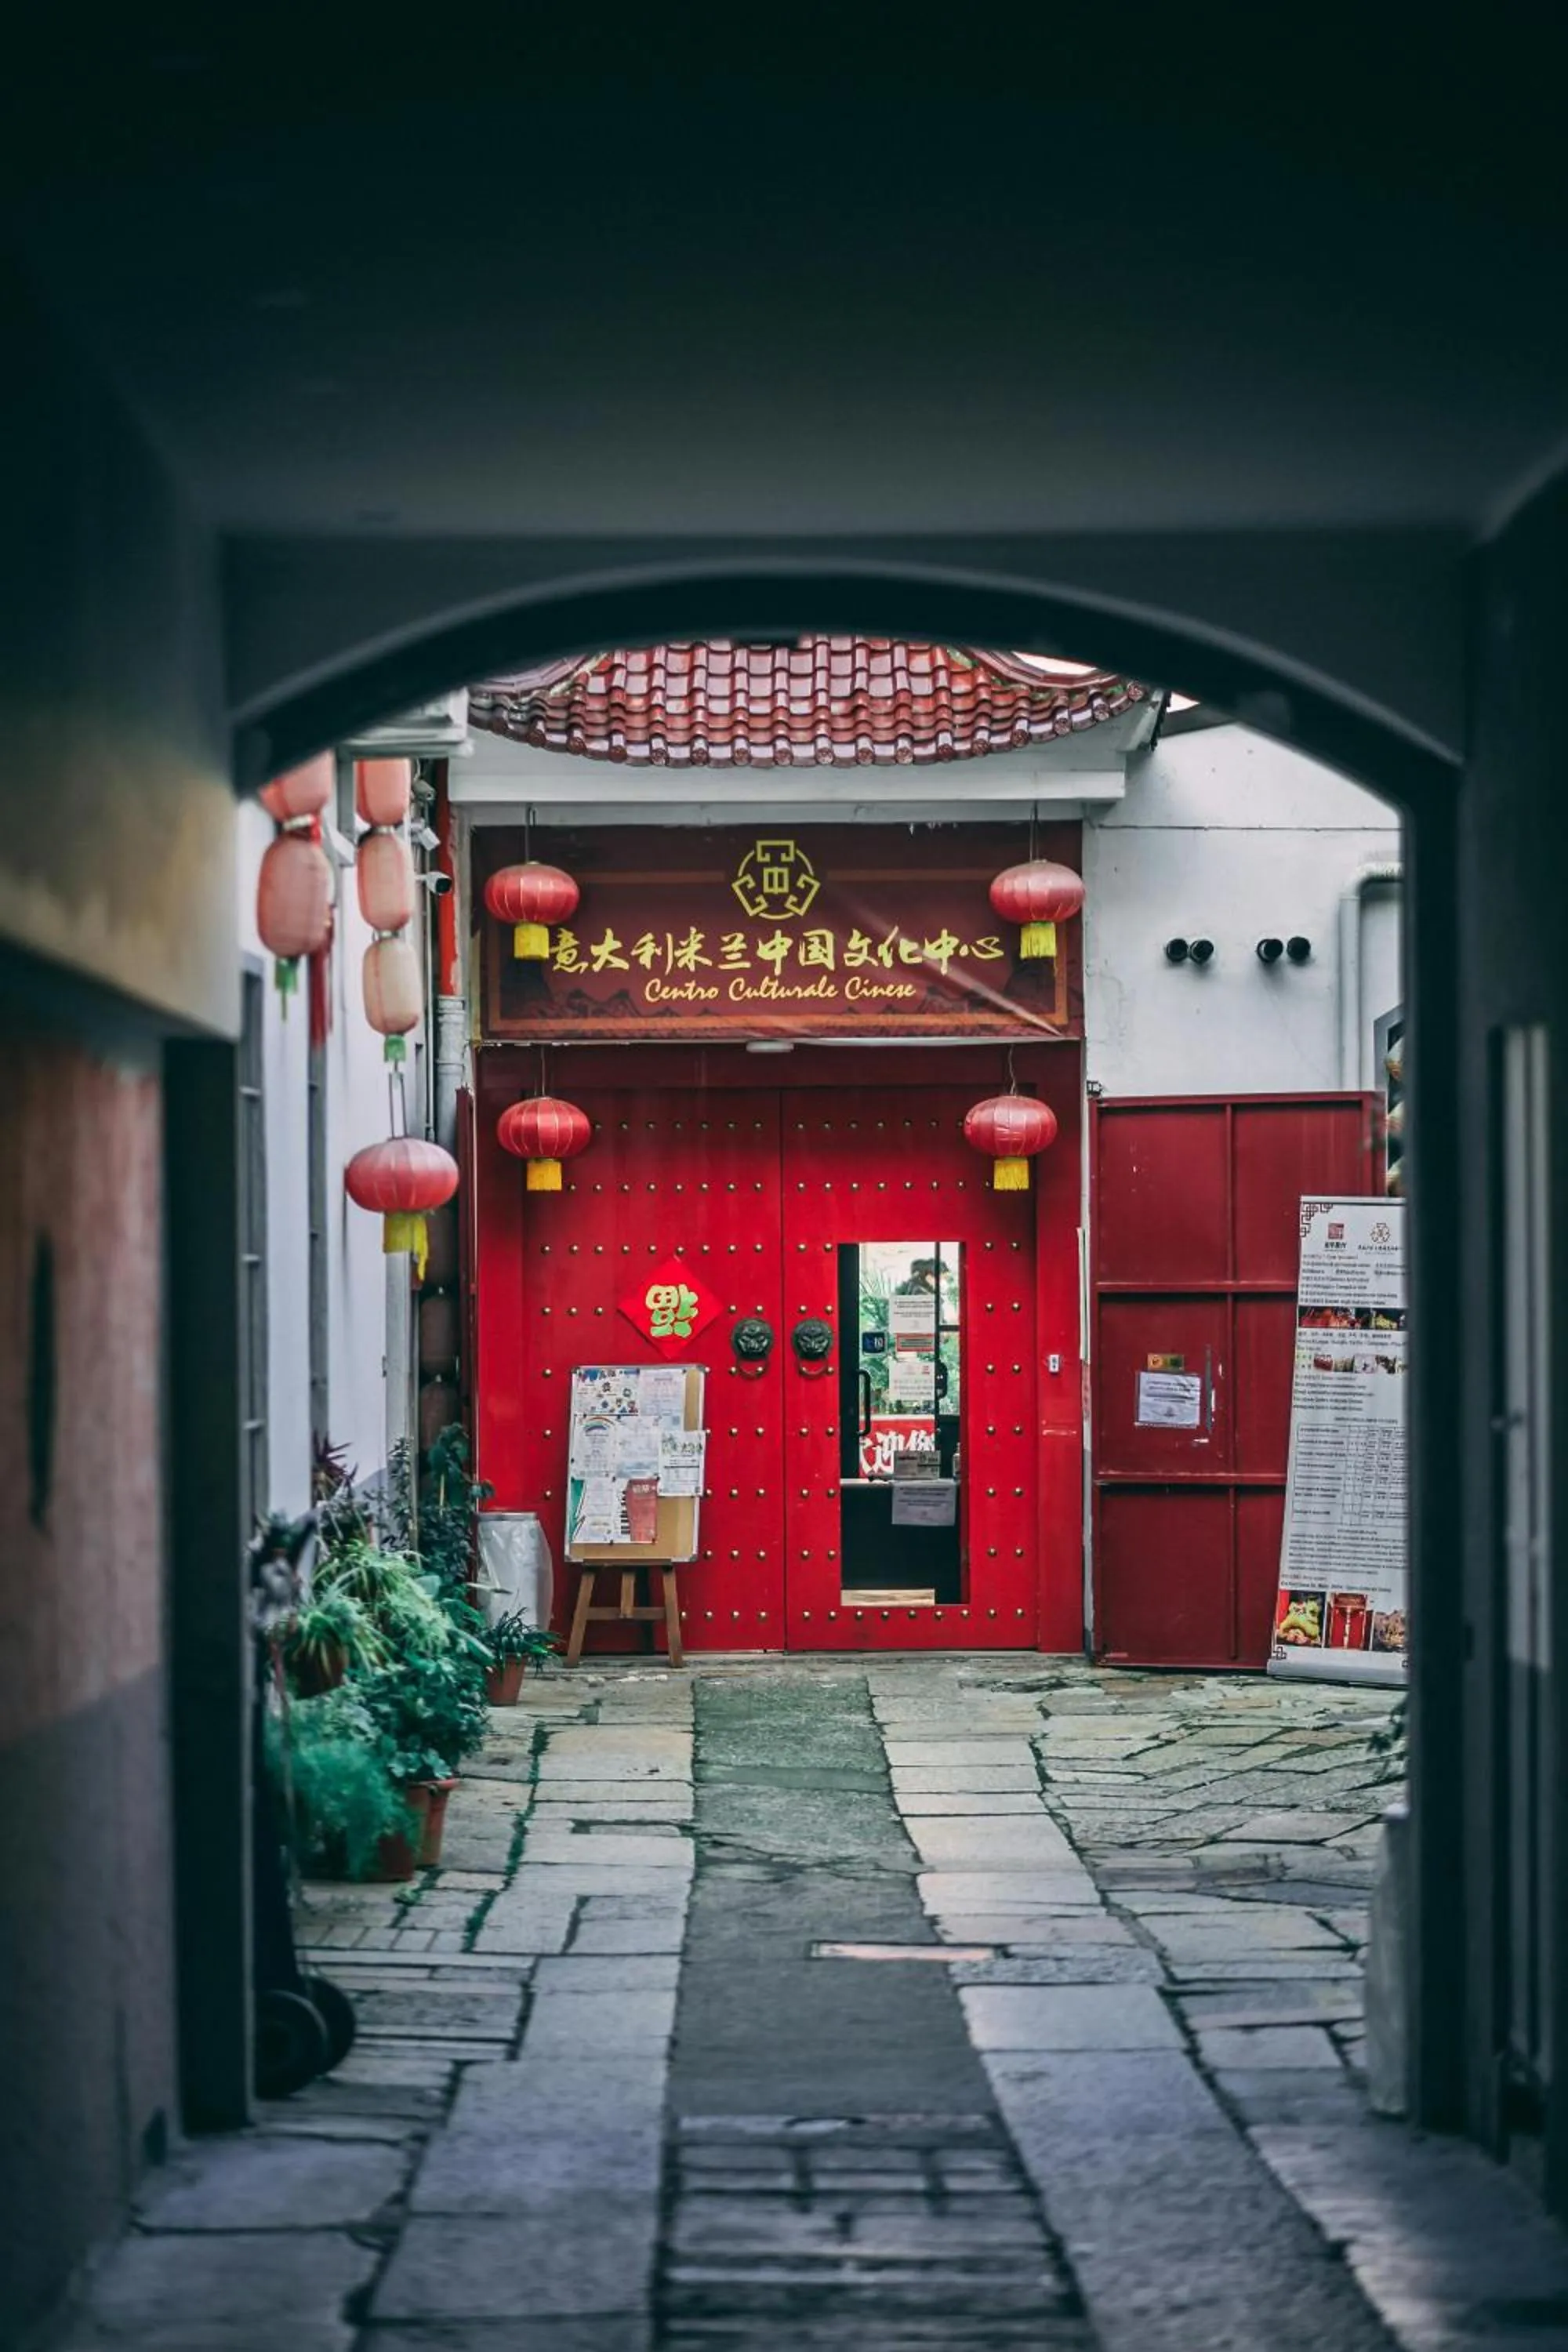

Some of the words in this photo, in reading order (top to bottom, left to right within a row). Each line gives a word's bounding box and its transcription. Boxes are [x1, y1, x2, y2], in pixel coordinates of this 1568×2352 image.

[550, 926, 1004, 976] 意大利米兰中国文化中心
[644, 978, 719, 1002] Centro
[728, 975, 838, 1001] Culturale
[844, 976, 916, 1000] Cinese
